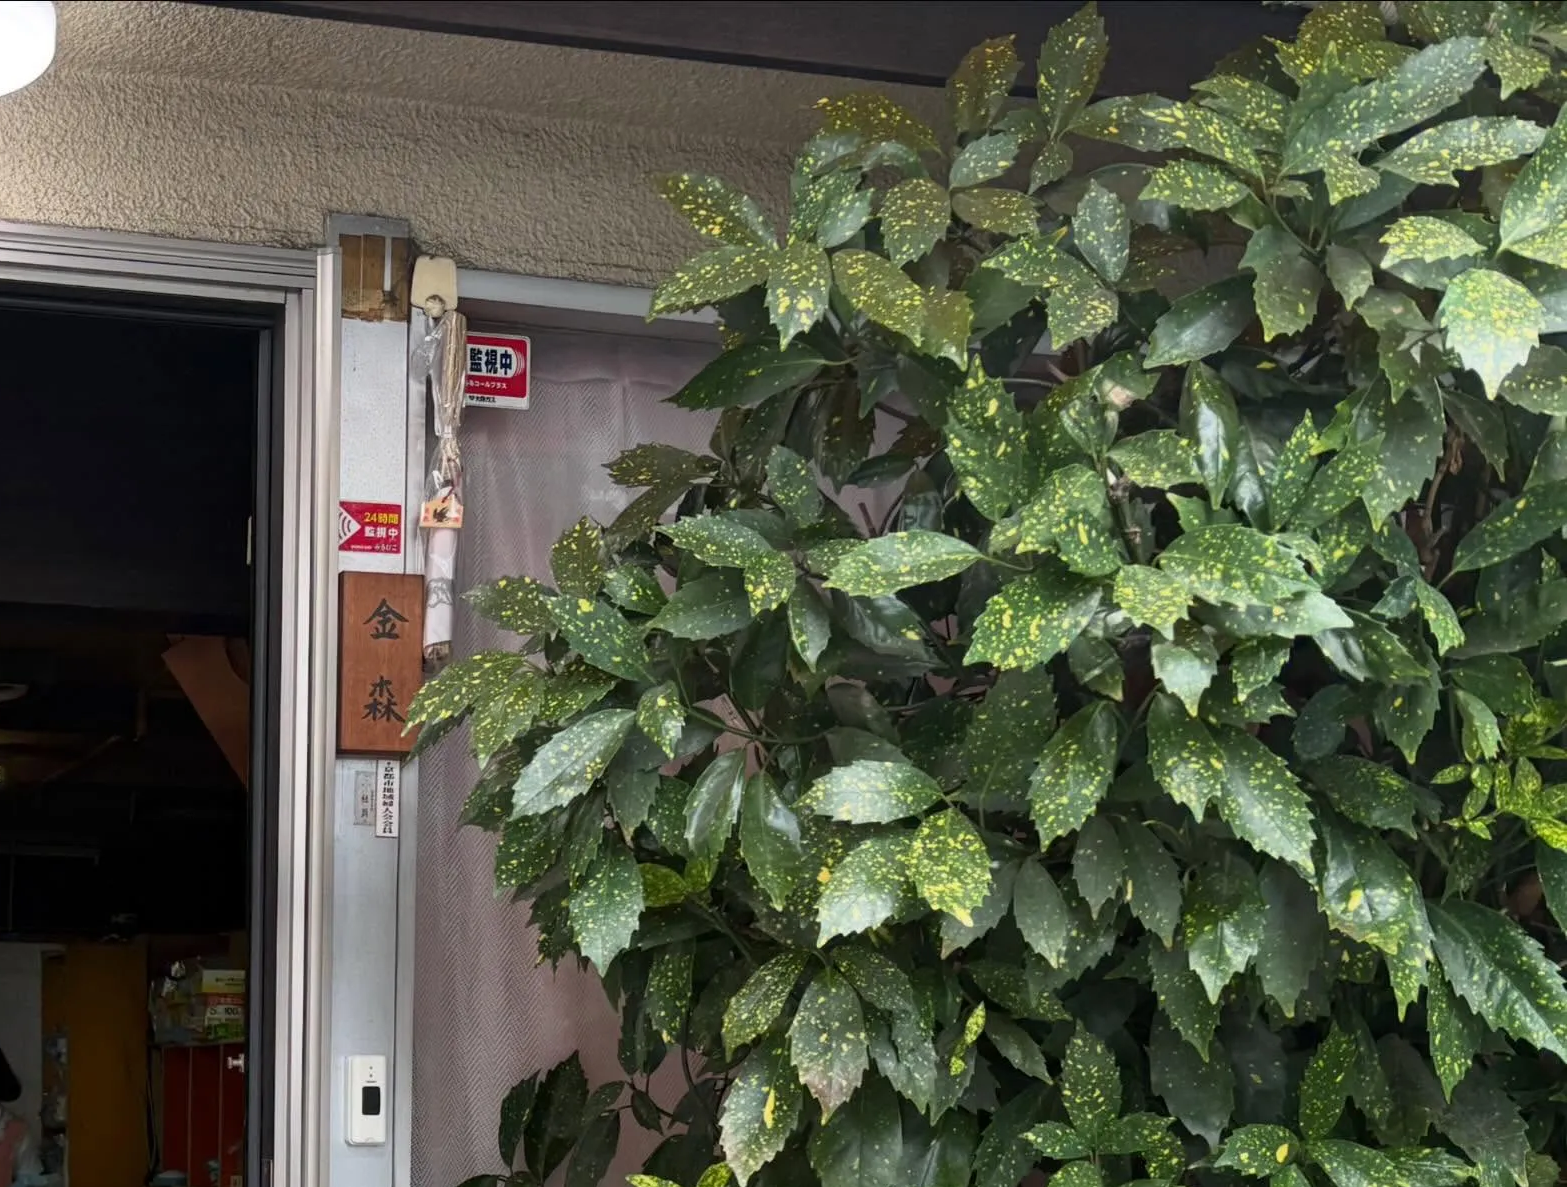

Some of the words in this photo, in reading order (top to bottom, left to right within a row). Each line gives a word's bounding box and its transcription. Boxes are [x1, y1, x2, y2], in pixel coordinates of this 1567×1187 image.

[469, 347, 512, 375] 監視中
[363, 512, 399, 525] 24時間
[363, 526, 399, 540] 監視中
[361, 597, 410, 724] 金森
